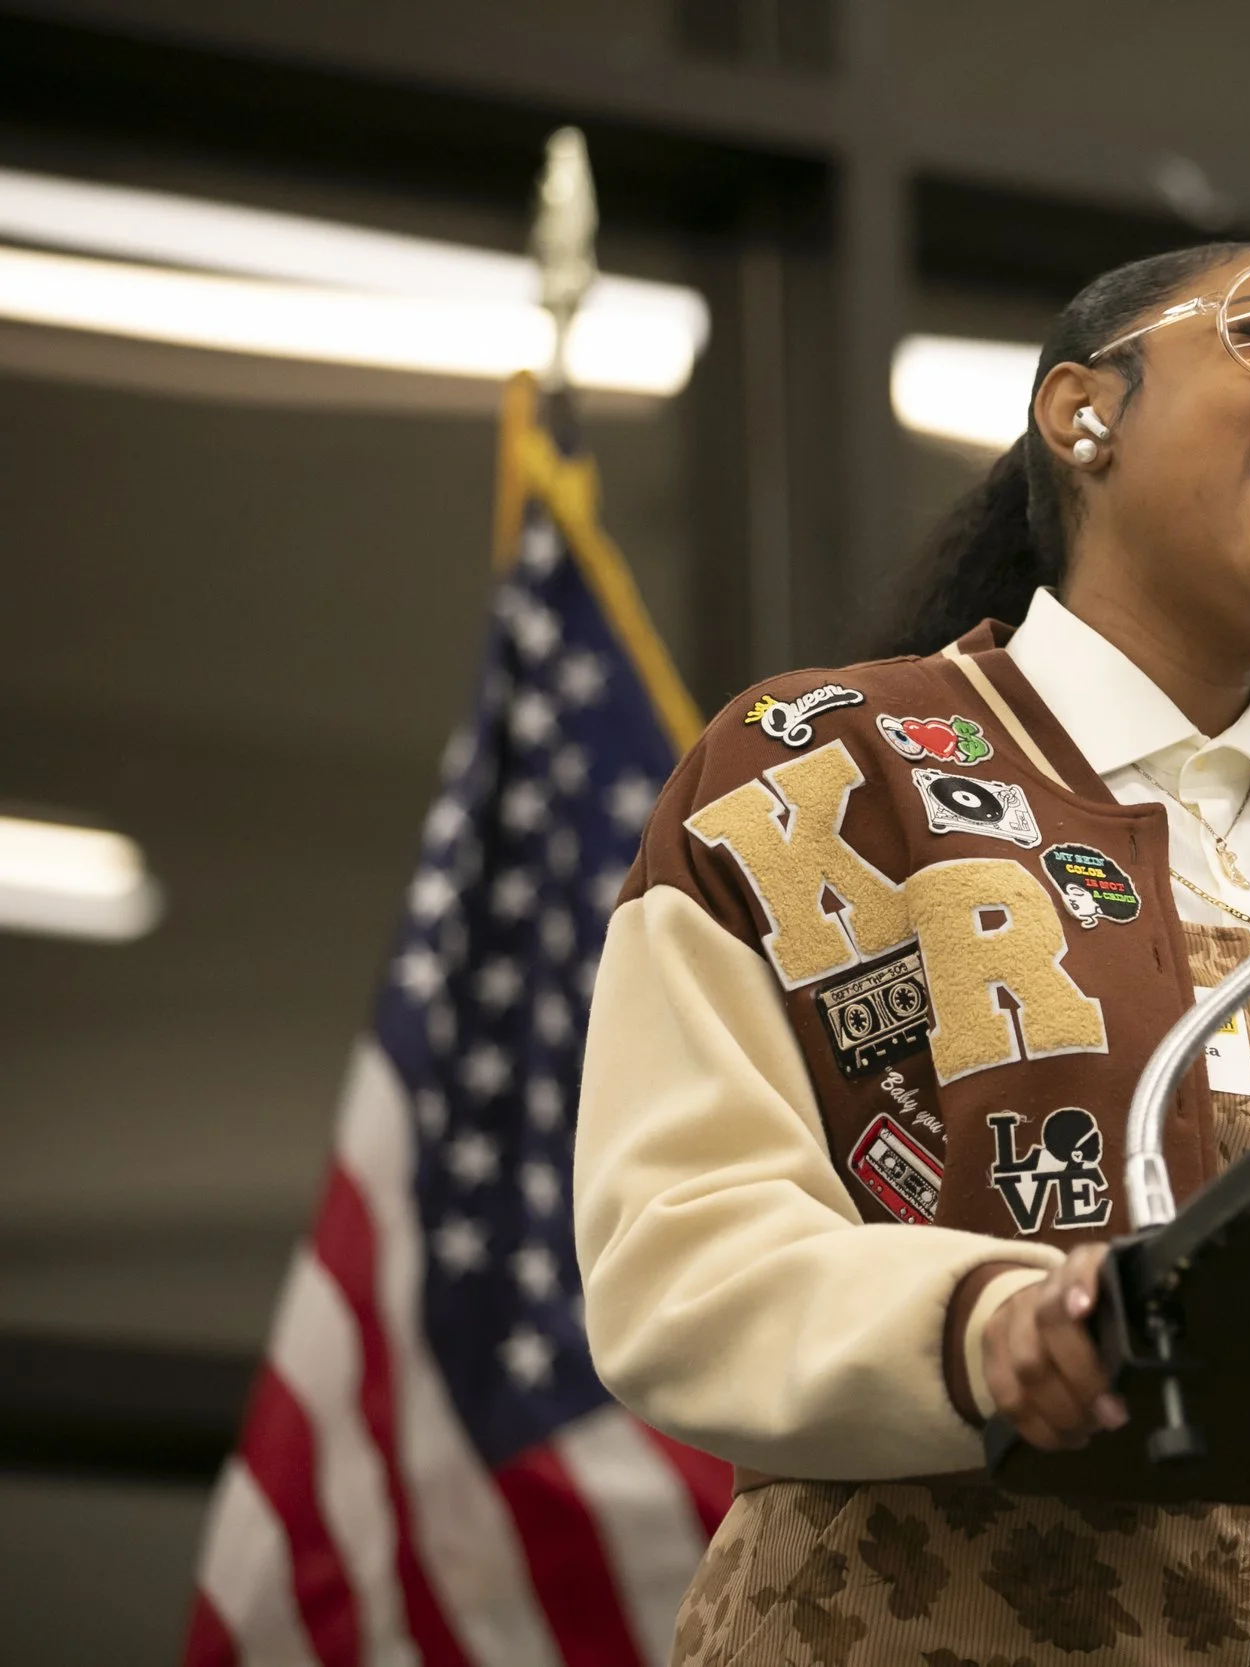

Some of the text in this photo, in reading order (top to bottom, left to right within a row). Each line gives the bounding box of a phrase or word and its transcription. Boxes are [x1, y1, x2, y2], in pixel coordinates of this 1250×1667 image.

[761, 684, 864, 747] Queen
[683, 738, 918, 992] K
[1053, 851, 1073, 862] MY
[1065, 864, 1107, 878] COLOR
[1099, 880, 1125, 892] NOT
[903, 858, 1109, 1087] R
[911, 1110, 945, 1134] you
